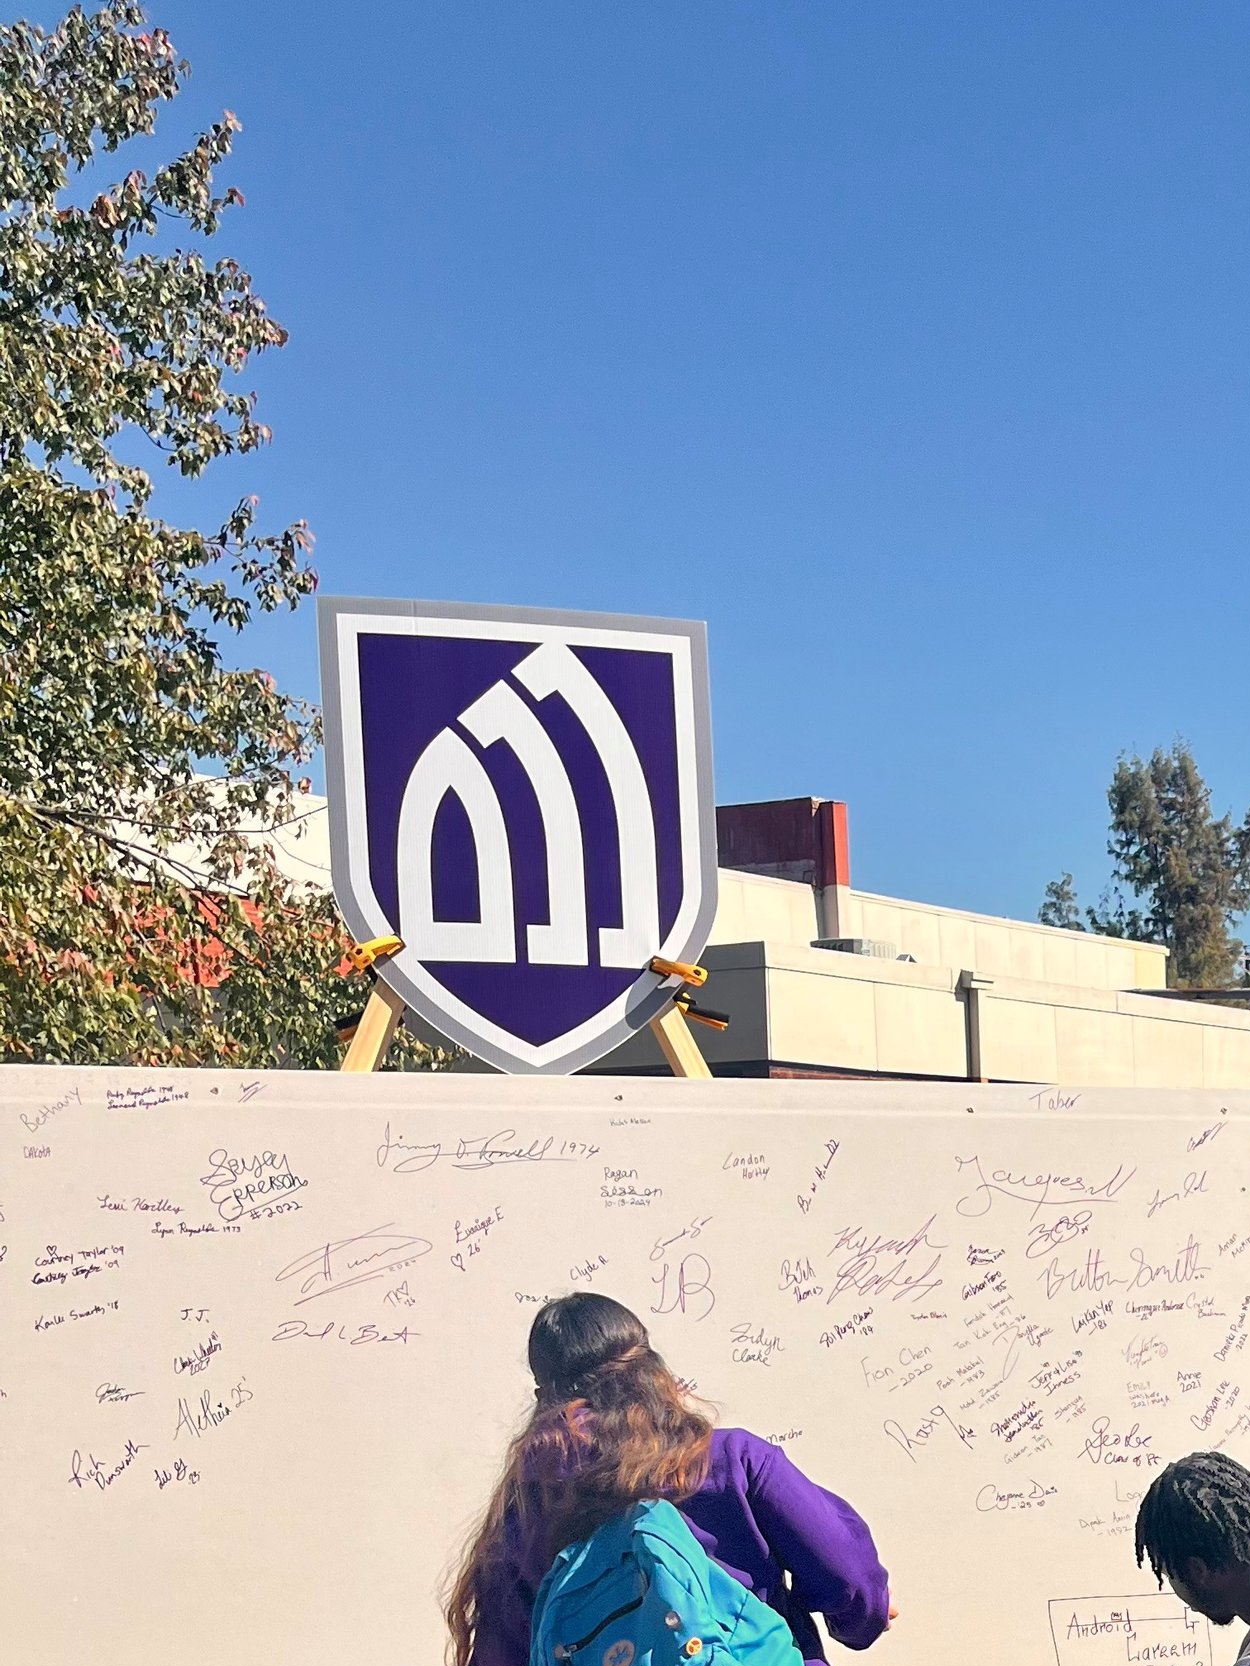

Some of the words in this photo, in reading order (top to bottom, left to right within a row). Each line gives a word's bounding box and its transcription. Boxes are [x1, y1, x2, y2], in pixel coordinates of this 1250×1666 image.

[20, 1087, 82, 1133] Bethany
[560, 1140, 600, 1159] 1974
[899, 1346, 932, 1366] Chen
[1067, 1608, 1133, 1640] Android
